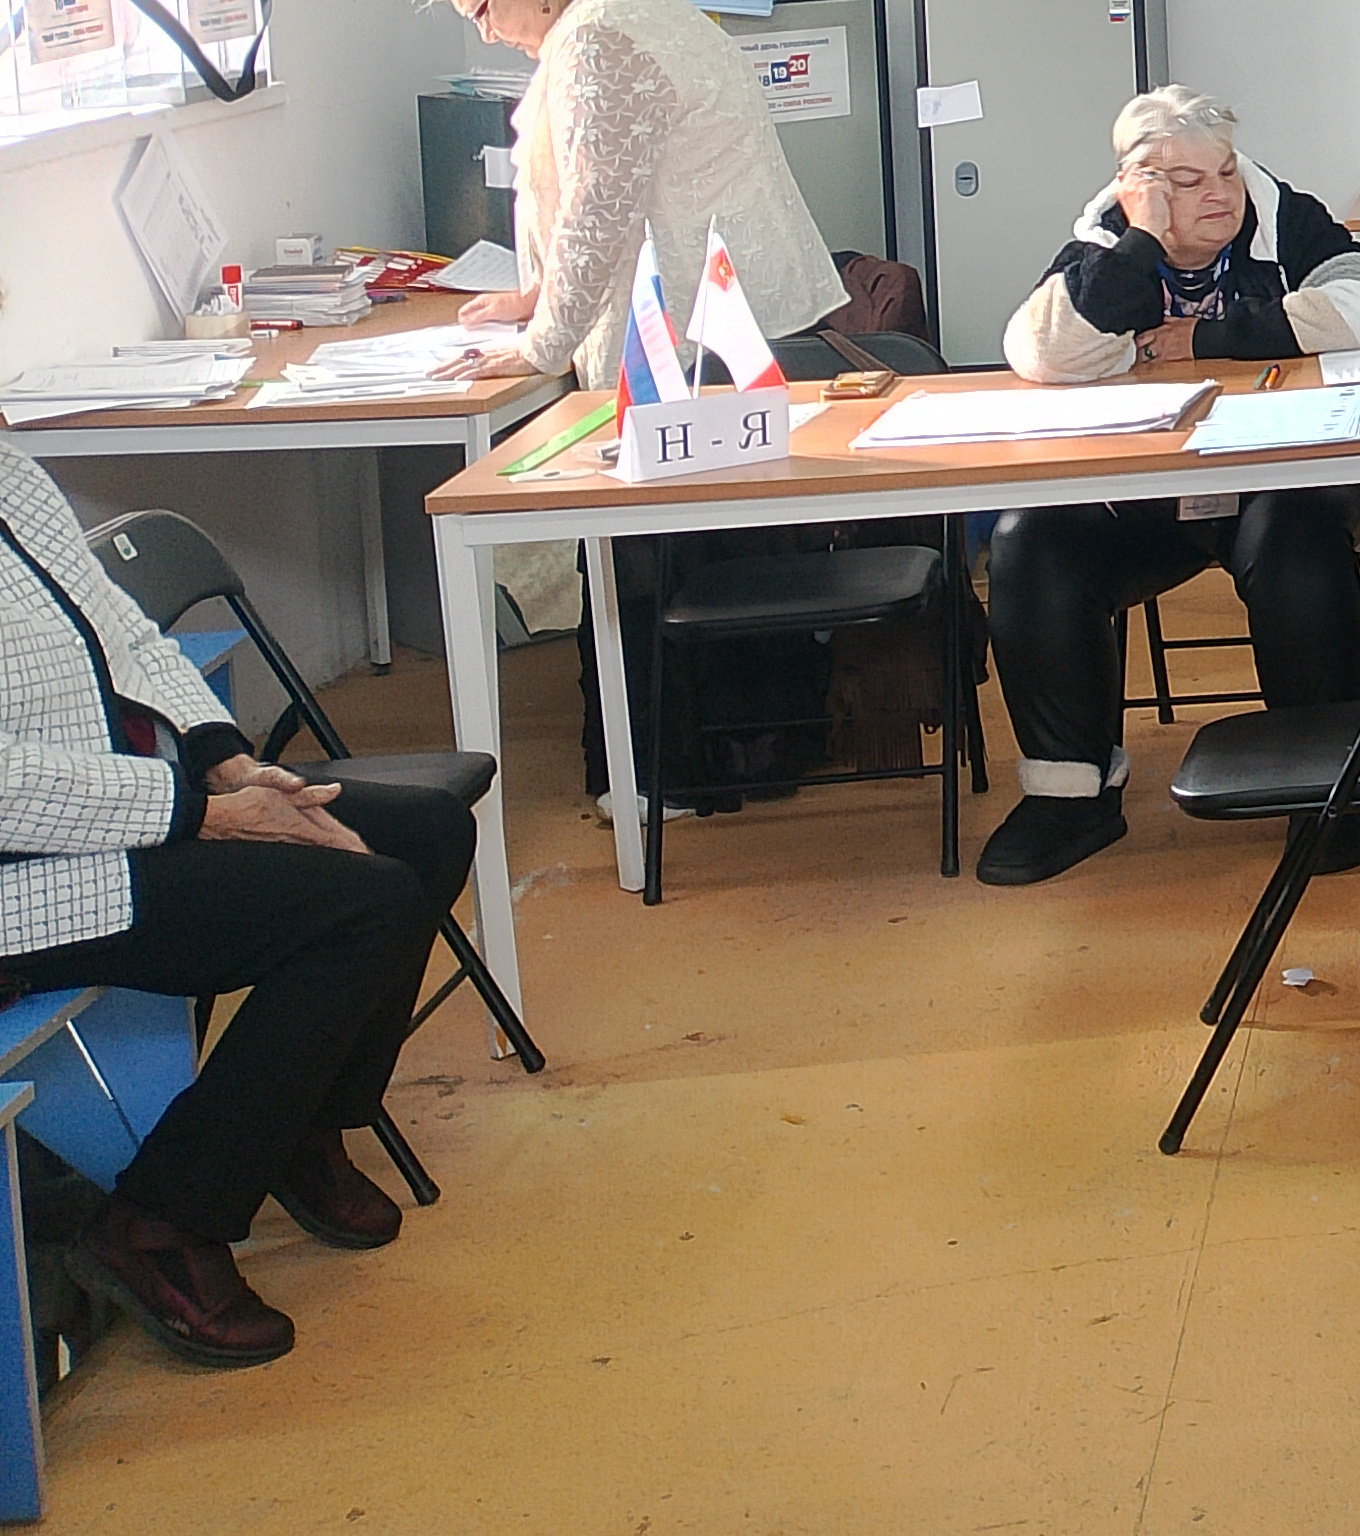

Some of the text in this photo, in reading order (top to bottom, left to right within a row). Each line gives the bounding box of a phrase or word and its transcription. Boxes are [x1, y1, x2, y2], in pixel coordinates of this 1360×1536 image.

[772, 67, 788, 79] 19
[788, 59, 806, 72] 20
[654, 422, 695, 464] Н
[738, 409, 773, 450] Я
